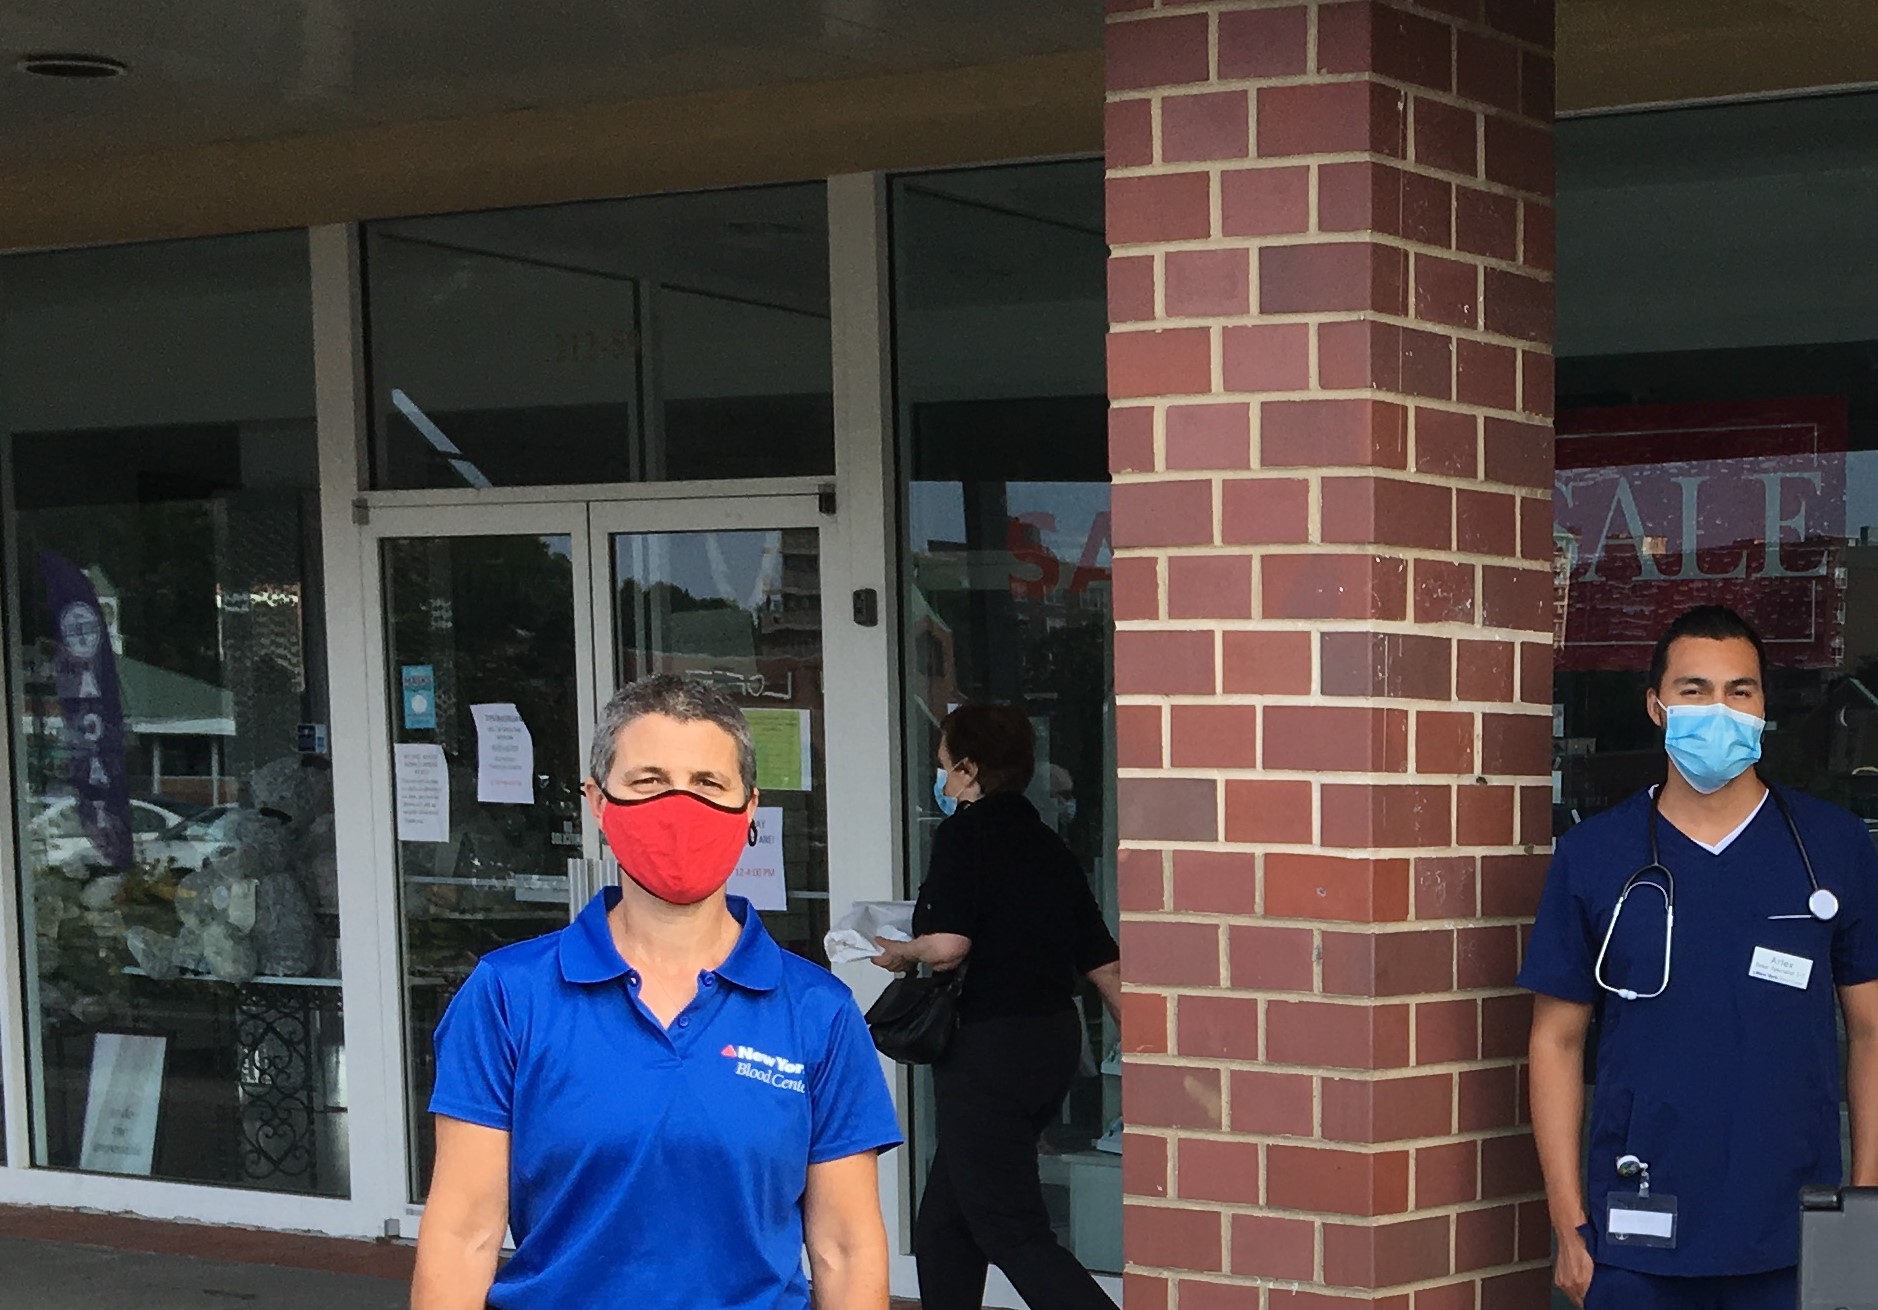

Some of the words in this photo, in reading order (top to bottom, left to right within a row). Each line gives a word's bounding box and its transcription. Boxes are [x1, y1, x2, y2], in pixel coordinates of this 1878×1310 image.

[735, 1061, 773, 1085] Blood
[737, 1045, 776, 1068] New
[775, 1055, 805, 1075] Yor
